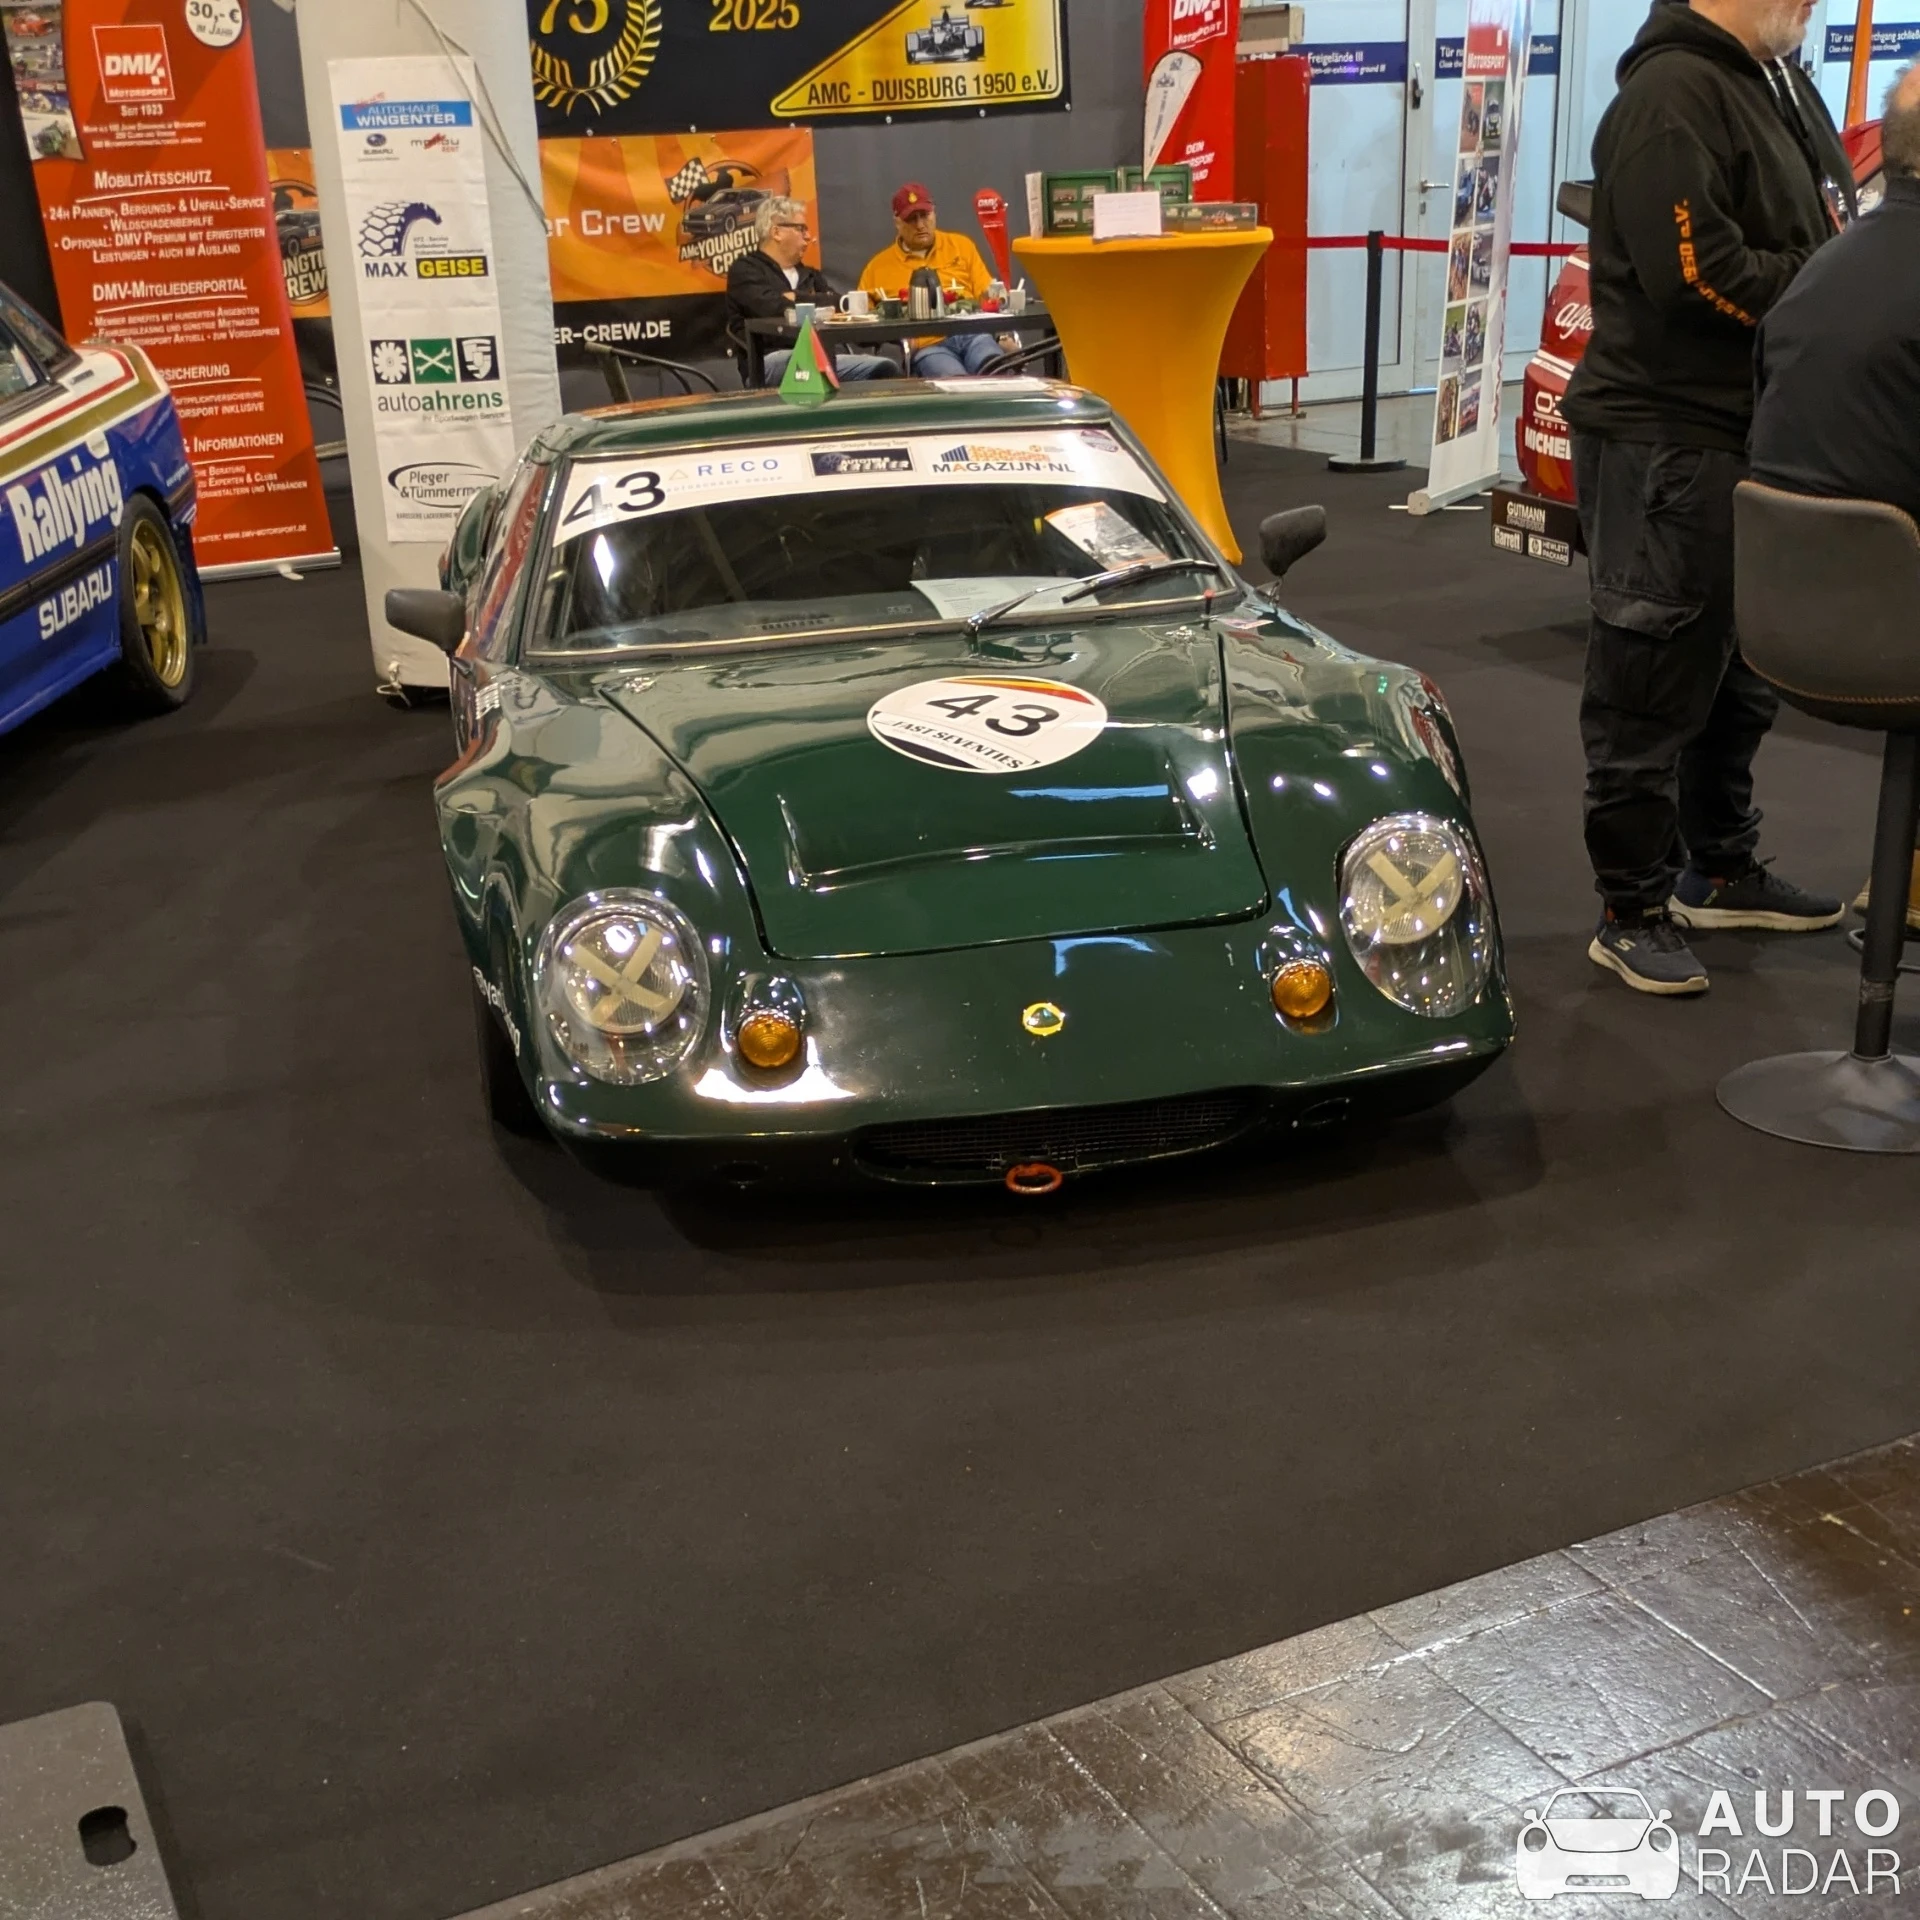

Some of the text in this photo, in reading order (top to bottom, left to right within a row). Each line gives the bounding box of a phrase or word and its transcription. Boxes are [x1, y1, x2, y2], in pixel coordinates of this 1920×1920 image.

[709, 0, 800, 32] 2025
[105, 53, 162, 77] DMV
[1307, 51, 1354, 66] Freigelände
[807, 81, 851, 106] AMC
[873, 75, 967, 102] DUISBURG
[973, 71, 1016, 95] 1950
[1021, 69, 1053, 92] e.V.
[356, 113, 456, 127] WINGENTER
[94, 169, 212, 189] MOBILITÄTSSCHUTZ
[581, 209, 666, 236] Crew
[115, 233, 142, 246] DMV
[365, 261, 408, 278] MAX
[418, 258, 485, 278] GEISE
[93, 278, 248, 301] DMV-MITGLIEDERPORTAL
[286, 269, 327, 298] REW
[378, 390, 504, 412] autoahrens
[194, 433, 284, 453] INFORMATIONEN
[409, 470, 450, 486] Pleger
[698, 459, 779, 477] RECO
[6, 455, 124, 563] Rallying
[561, 470, 666, 526] 43
[1506, 501, 1546, 523] GUTMANN
[1494, 526, 1520, 551] Garrett
[38, 563, 113, 641] SUBARU
[926, 694, 1060, 737] 43
[933, 731, 1024, 769] SEVENTIES
